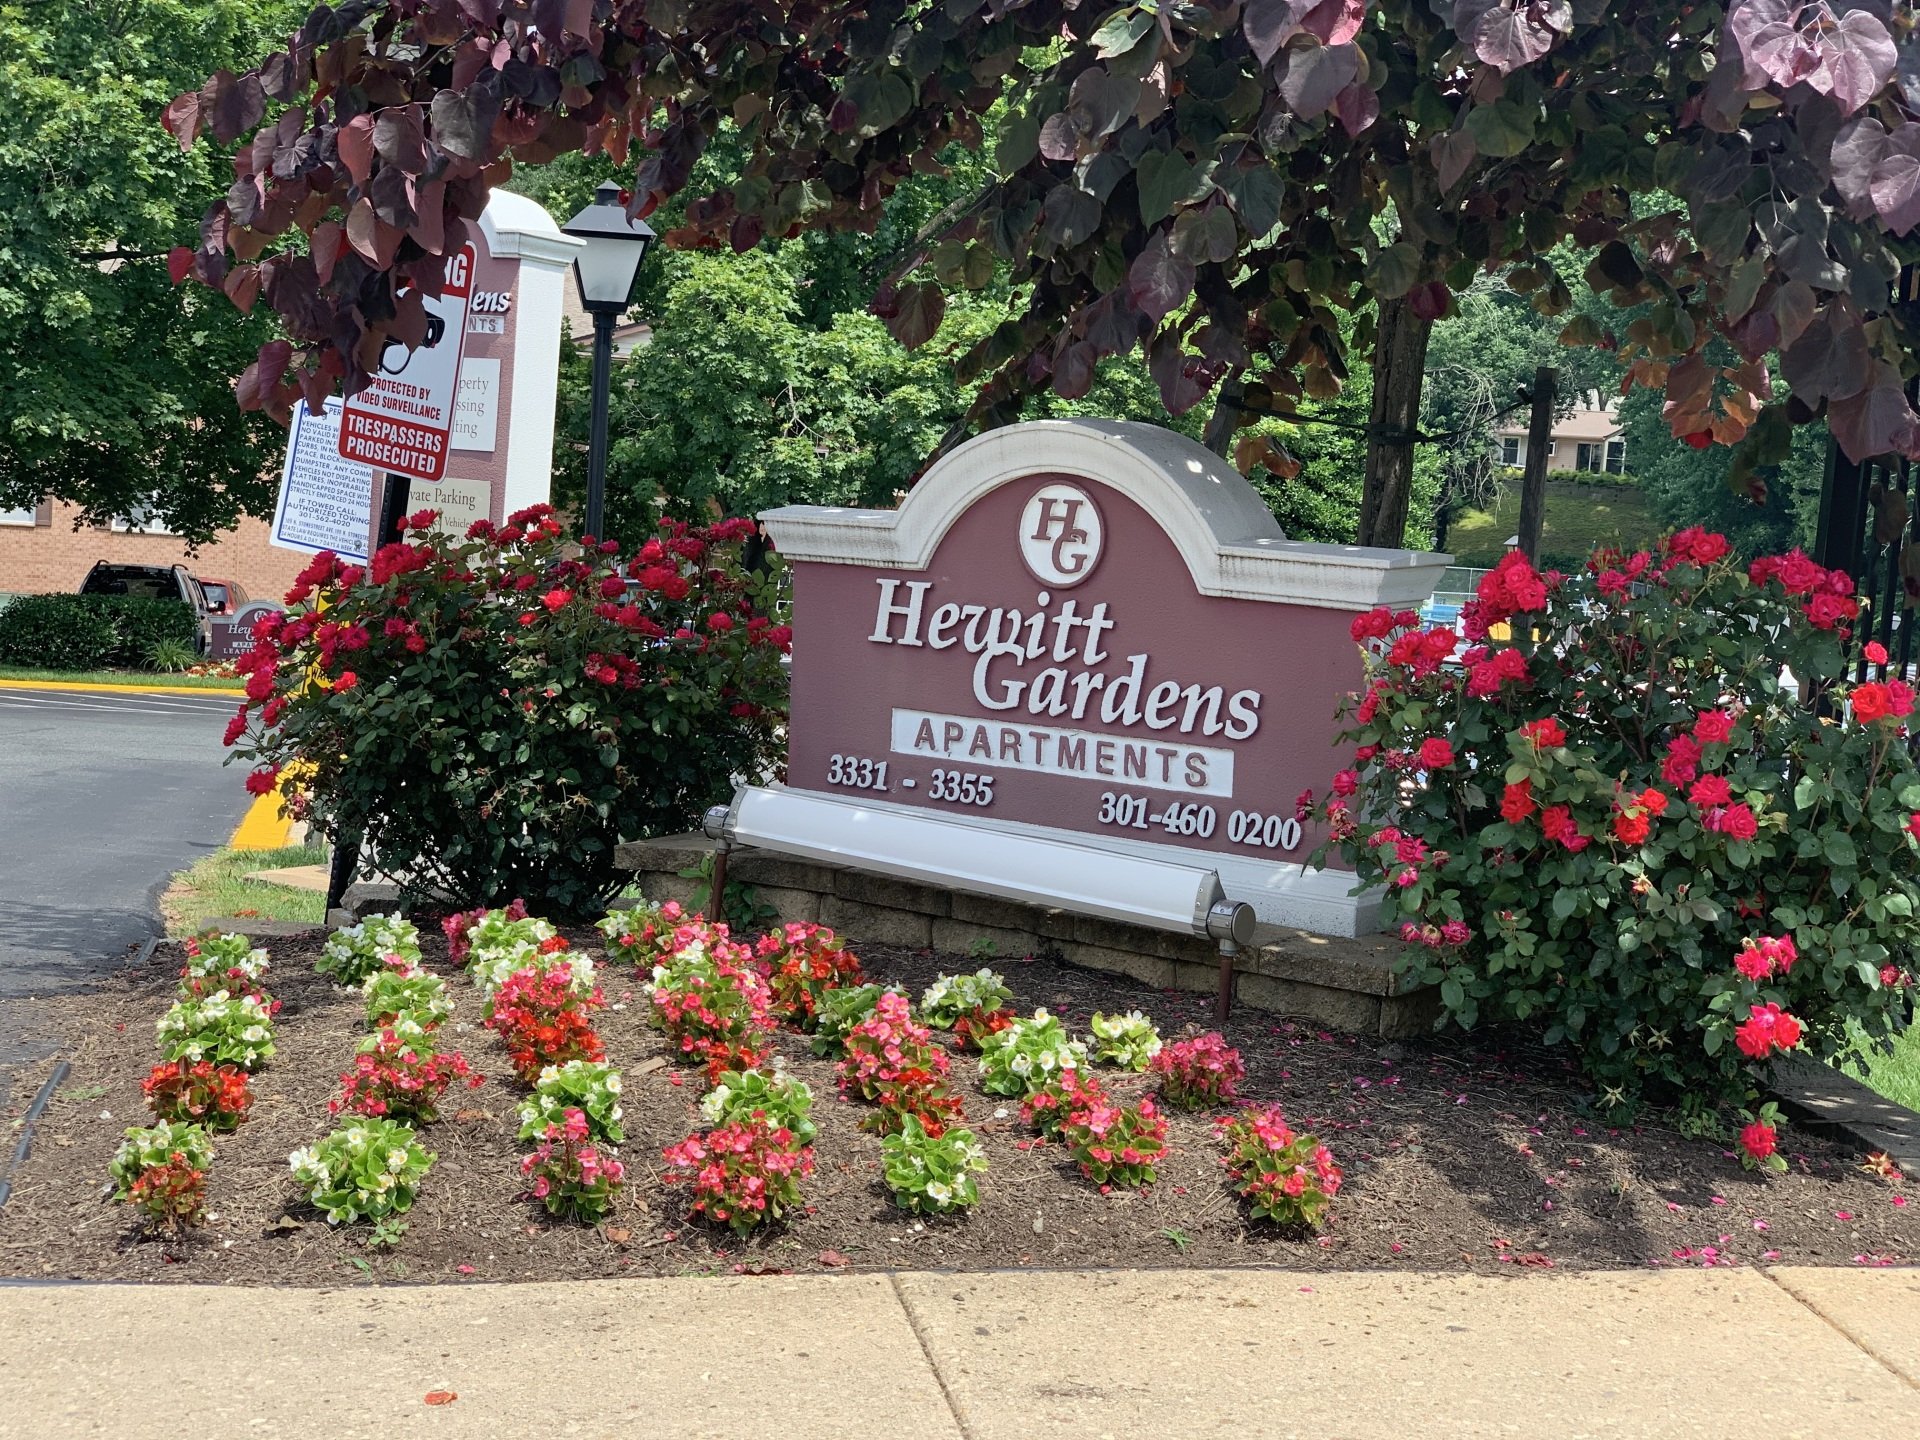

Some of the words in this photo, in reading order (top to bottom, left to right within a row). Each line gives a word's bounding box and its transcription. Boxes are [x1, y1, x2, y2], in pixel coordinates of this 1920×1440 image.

[371, 377, 417, 398] PROTECTED
[419, 387, 431, 401] BY
[459, 377, 489, 394] perty
[329, 408, 341, 416] PER
[357, 392, 380, 406] VIDEO
[382, 396, 441, 420] SURVEILLANCE
[456, 398, 485, 416] ssing
[302, 420, 332, 431] VEHICLES
[313, 429, 331, 438] VALID
[348, 414, 442, 453] TRESPASSERS
[300, 434, 324, 444] PARKED
[346, 436, 436, 474] PROSECUTED
[295, 465, 320, 475] VEHICLES
[336, 474, 370, 486] DISPLAYING
[334, 465, 349, 473] ANY
[350, 469, 371, 478] COMM
[292, 480, 335, 493] HANDICAPPED
[337, 489, 356, 498] SPACE
[293, 472, 307, 480] FLAT
[327, 479, 364, 492] INOPERABLE
[290, 487, 315, 496] STRICTLY
[317, 492, 346, 503] ENFORCED
[308, 500, 334, 510] TOWED
[410, 490, 431, 502] vate
[434, 487, 476, 511] Parking
[287, 503, 337, 518] AUTHORIZED
[339, 514, 369, 525] TOWING
[299, 512, 350, 527] 301-562-4020
[867, 578, 1116, 667] Hewitt
[973, 643, 1262, 740] Gardens
[914, 717, 1209, 788] APARTMENTS
[828, 754, 889, 792] 3331
[929, 769, 995, 806] 3355
[1098, 794, 1216, 838] 301-460
[1228, 810, 1301, 850] 0200
